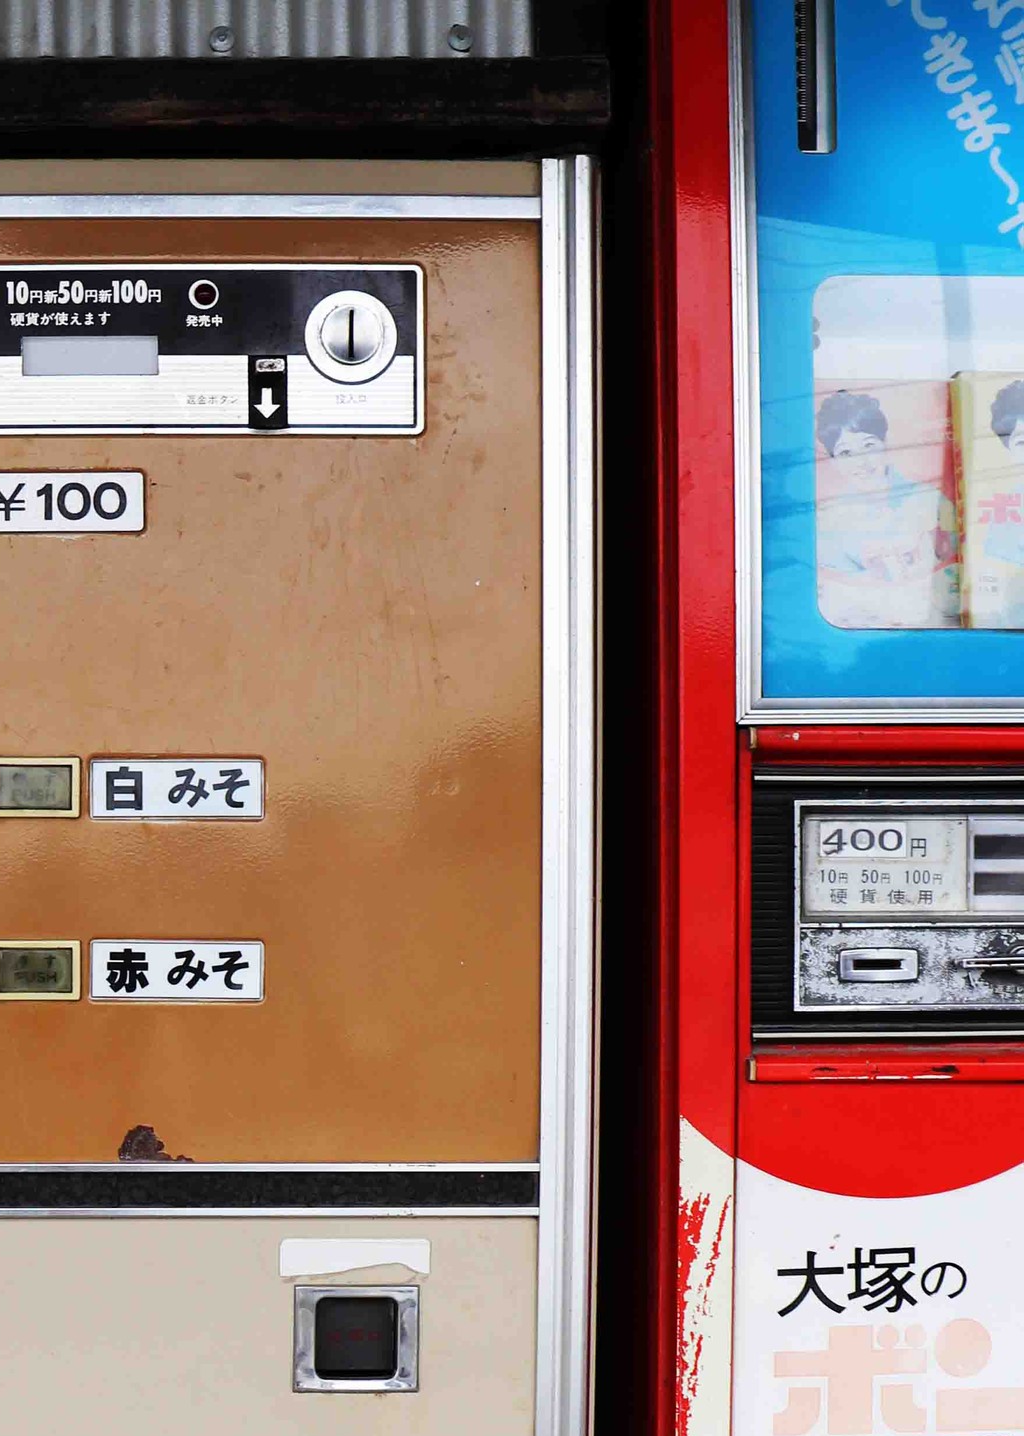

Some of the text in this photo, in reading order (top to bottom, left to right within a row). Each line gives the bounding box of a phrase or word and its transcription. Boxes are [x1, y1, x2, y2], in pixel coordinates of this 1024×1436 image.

[10, 311, 112, 327] 硬貨が使えます
[186, 313, 224, 328] 発売中
[106, 766, 251, 811] 白 みそ
[820, 869, 943, 885] 10円 50円 100円
[106, 948, 250, 993] 赤 みそ
[777, 1247, 967, 1318] 大塚の
